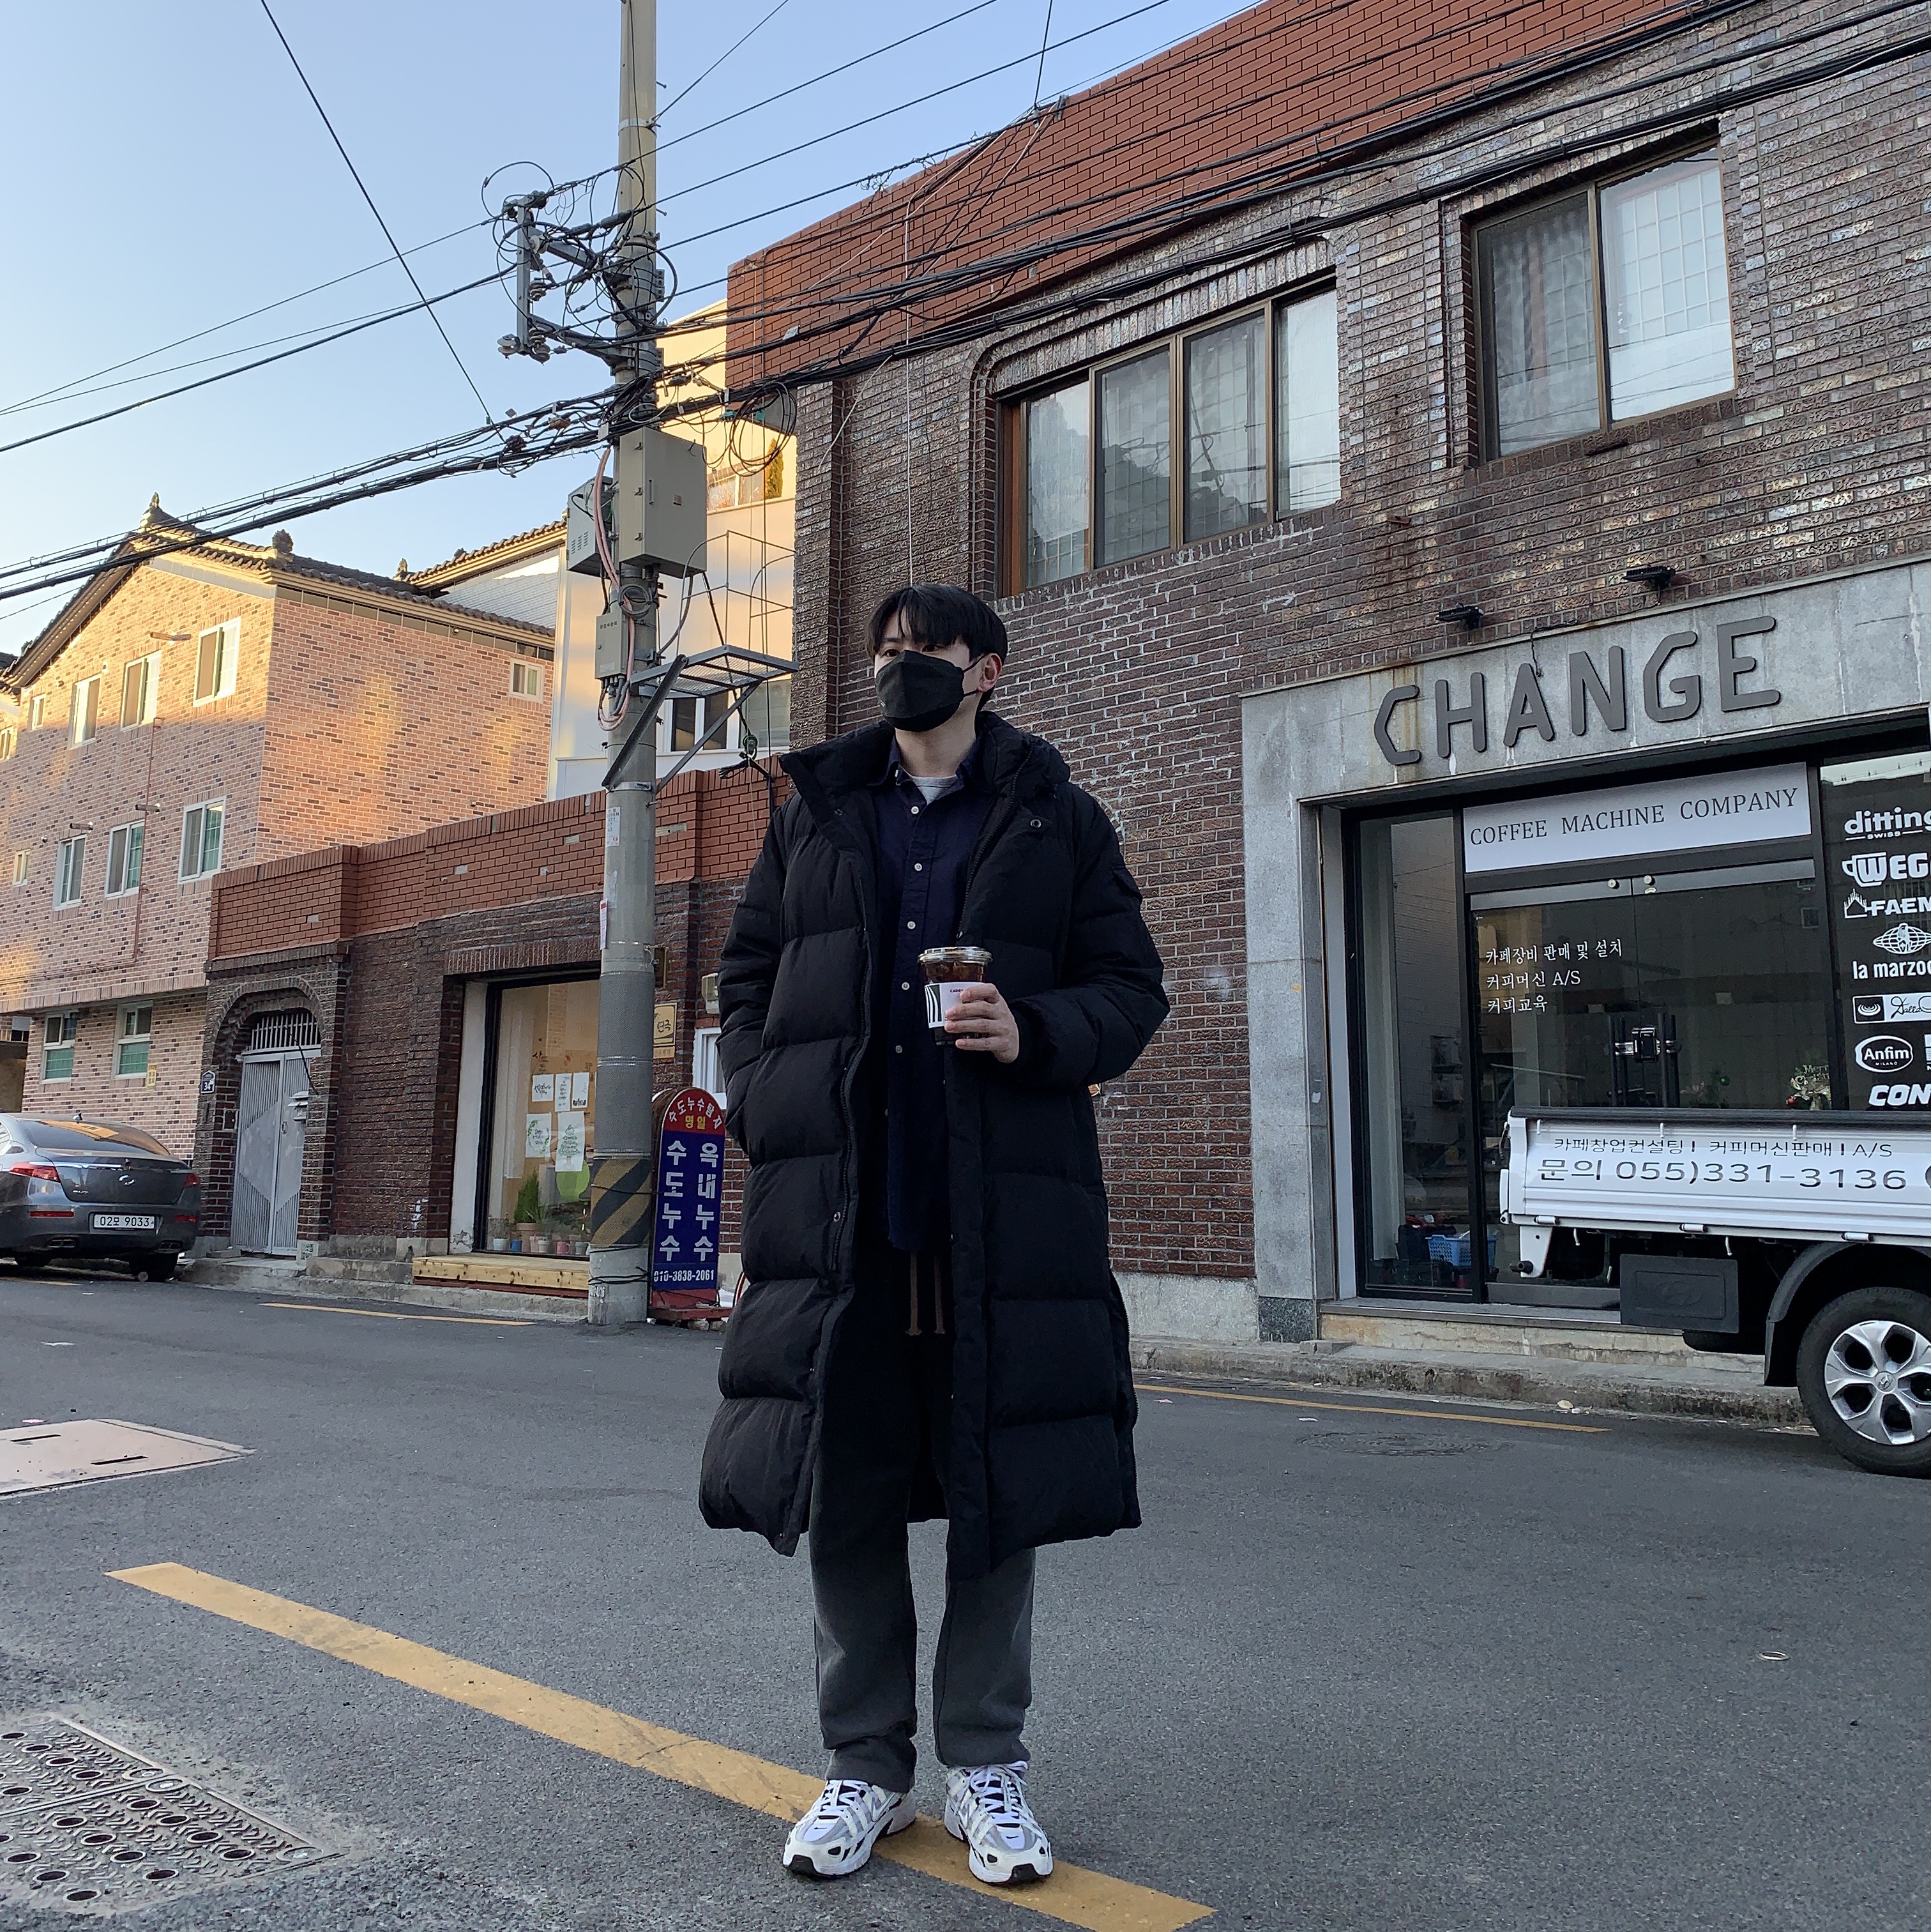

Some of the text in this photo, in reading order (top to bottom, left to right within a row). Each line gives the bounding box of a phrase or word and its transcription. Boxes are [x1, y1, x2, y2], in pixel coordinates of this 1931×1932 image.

[1374, 615, 1782, 766] CHANGE
[1470, 787, 1798, 846] COFFEE MACHINE COMPANY
[1867, 831, 1902, 840] SWISS
[1485, 938, 1623, 966] 카페장비 판매 및 설치
[1486, 970, 1581, 991] 커피머신 A/S
[1852, 961, 1868, 979] la
[1487, 994, 1548, 1014] 커피교육
[1863, 1046, 1910, 1061] Anfim
[669, 1097, 723, 1130] 수도누수탐지
[685, 1114, 706, 1130] 명일
[1554, 1137, 1893, 1159] 카페창업컨설팅 커피머신판매 A/S
[1537, 1159, 1907, 1190] 문의 055)331-3136
[125, 1217, 150, 1227] 9033
